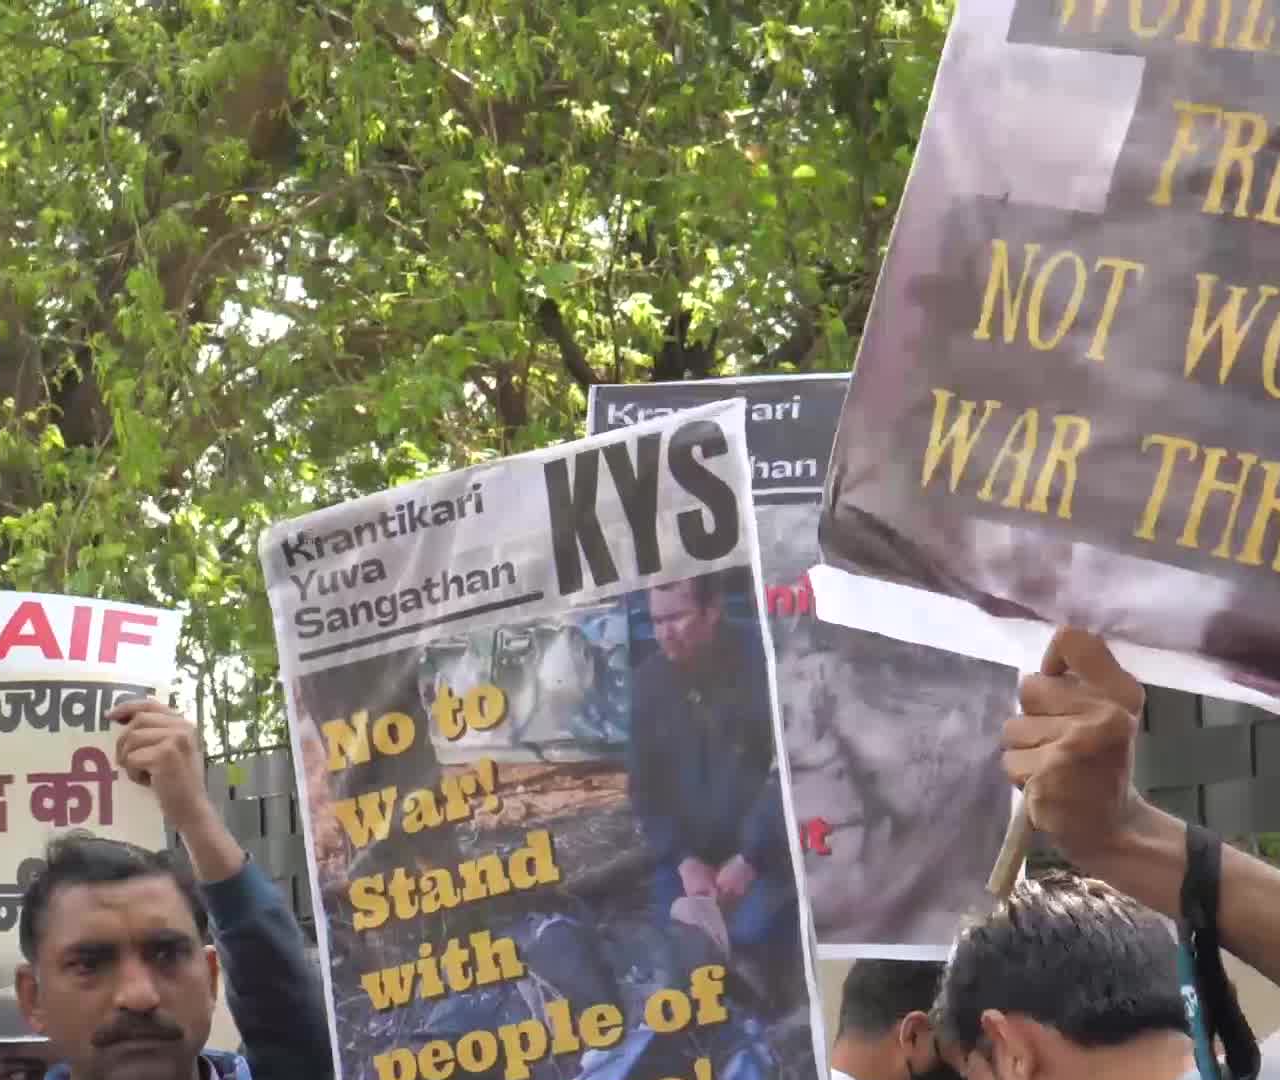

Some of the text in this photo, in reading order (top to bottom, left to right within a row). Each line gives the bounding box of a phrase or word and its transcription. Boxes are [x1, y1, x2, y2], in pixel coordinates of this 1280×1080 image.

[972, 240, 1144, 362] NOT
[921, 388, 1092, 520] WAR
[281, 483, 485, 569] Krantikari
[543, 420, 738, 597] KYS
[288, 556, 387, 602] Yuva
[294, 560, 517, 641] Sangathan
[321, 681, 508, 773] No to
[27, 747, 118, 827] की
[334, 759, 500, 850] War!
[348, 829, 561, 933] Stand
[360, 928, 526, 1011] with
[645, 964, 729, 1034] of
